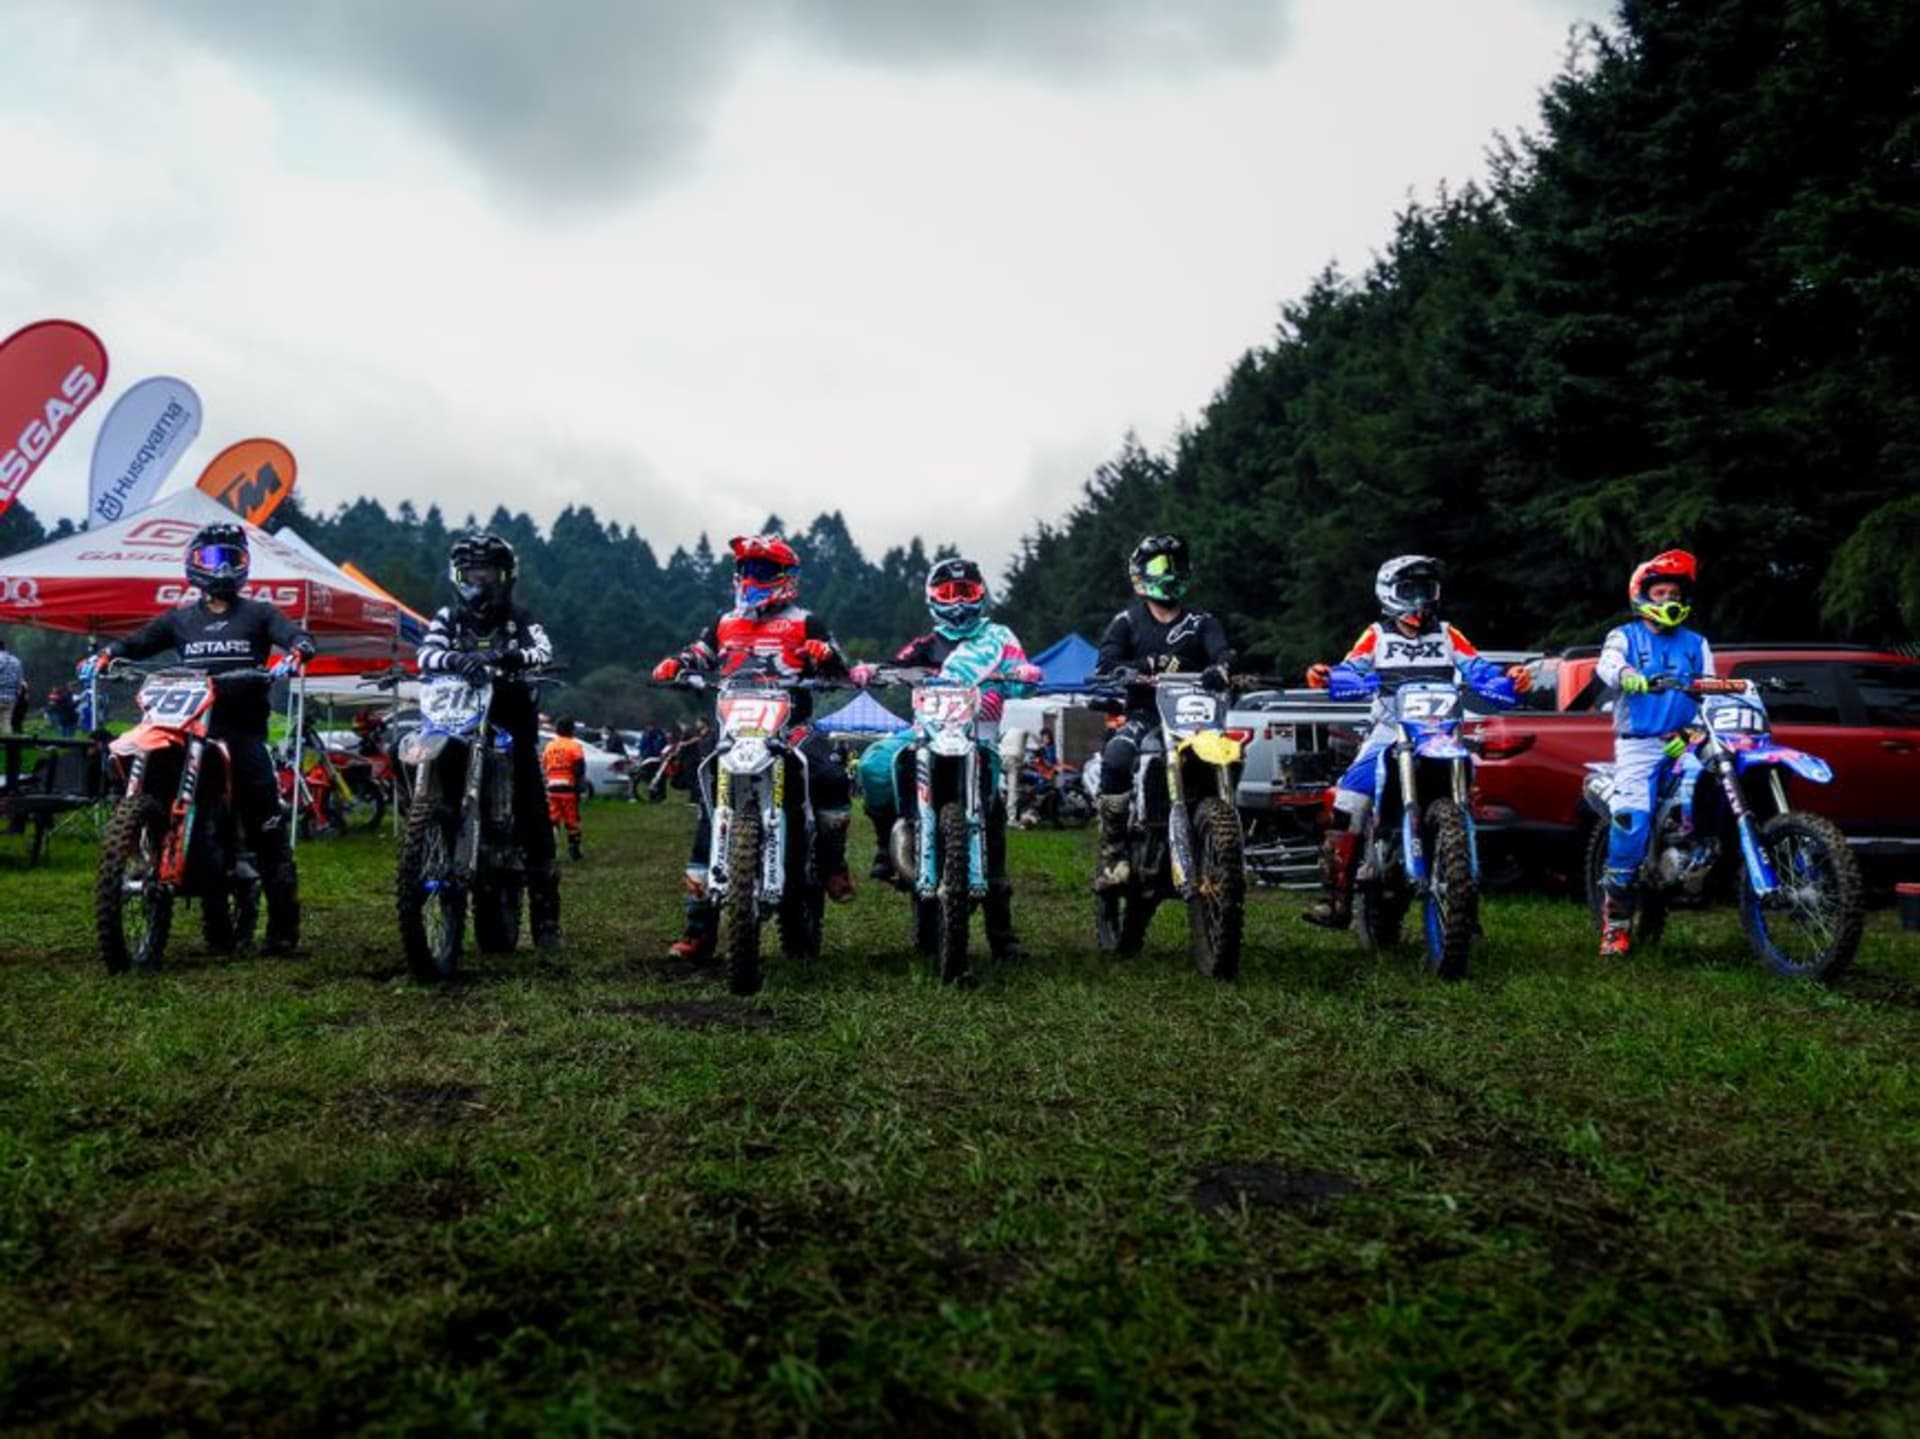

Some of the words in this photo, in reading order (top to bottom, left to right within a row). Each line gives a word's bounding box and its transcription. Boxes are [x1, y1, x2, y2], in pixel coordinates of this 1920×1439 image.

[0, 365, 97, 499] SGAS
[113, 401, 183, 500] Husqvarna
[216, 462, 283, 518] TM
[77, 551, 183, 562] GASG
[155, 585, 299, 606] GAGAS
[1385, 641, 1445, 661] FOX
[143, 689, 207, 716] 791
[1405, 693, 1457, 717] 57
[1713, 707, 1764, 731] 211
